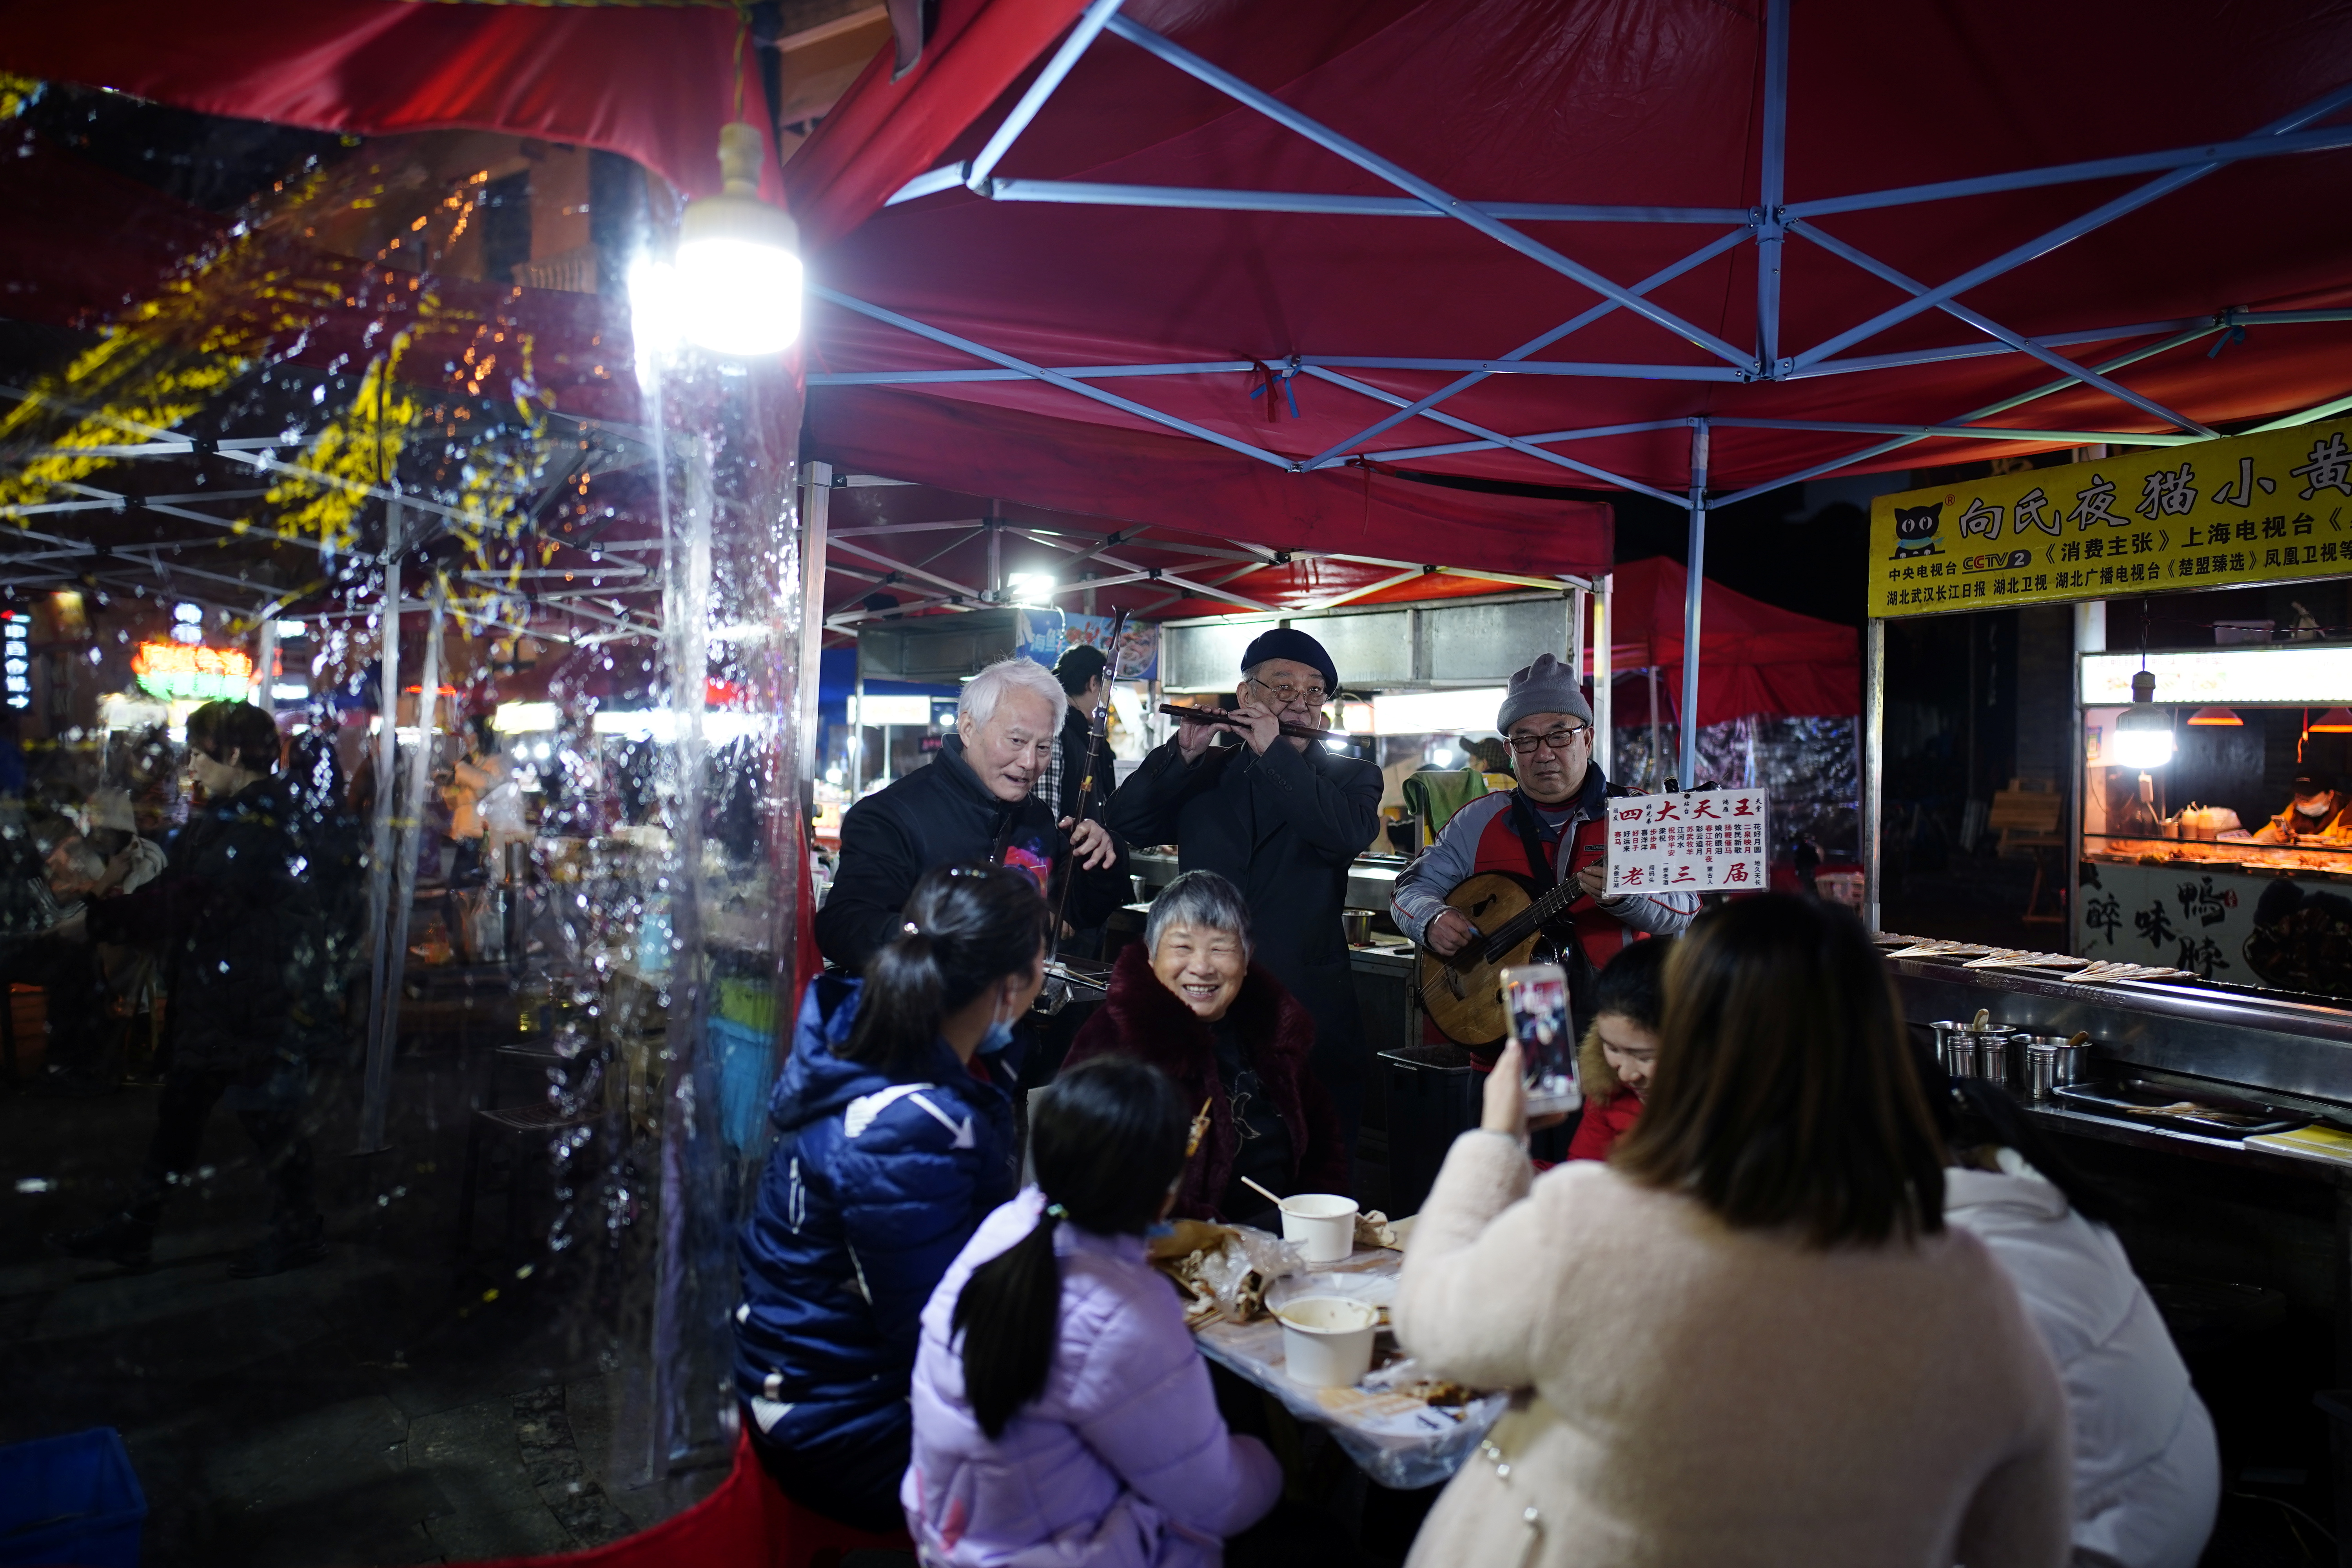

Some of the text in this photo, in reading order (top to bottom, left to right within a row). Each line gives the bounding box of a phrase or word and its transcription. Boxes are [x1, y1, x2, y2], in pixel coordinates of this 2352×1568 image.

[1959, 432, 2352, 540] 向氏夜猫小黄
[1889, 561, 1957, 582] 中央电视台
[1887, 581, 1985, 606] 湖北武汉长江日报
[1993, 574, 2047, 595] 湖北卫视
[1684, 801, 1690, 815] 站台
[1722, 799, 1729, 813] 鸿雁
[1755, 798, 1762, 812] 天堂
[1614, 831, 1621, 845] 赛马
[1659, 828, 1666, 842] 梁祝
[1734, 824, 1742, 853] 牧民新歌
